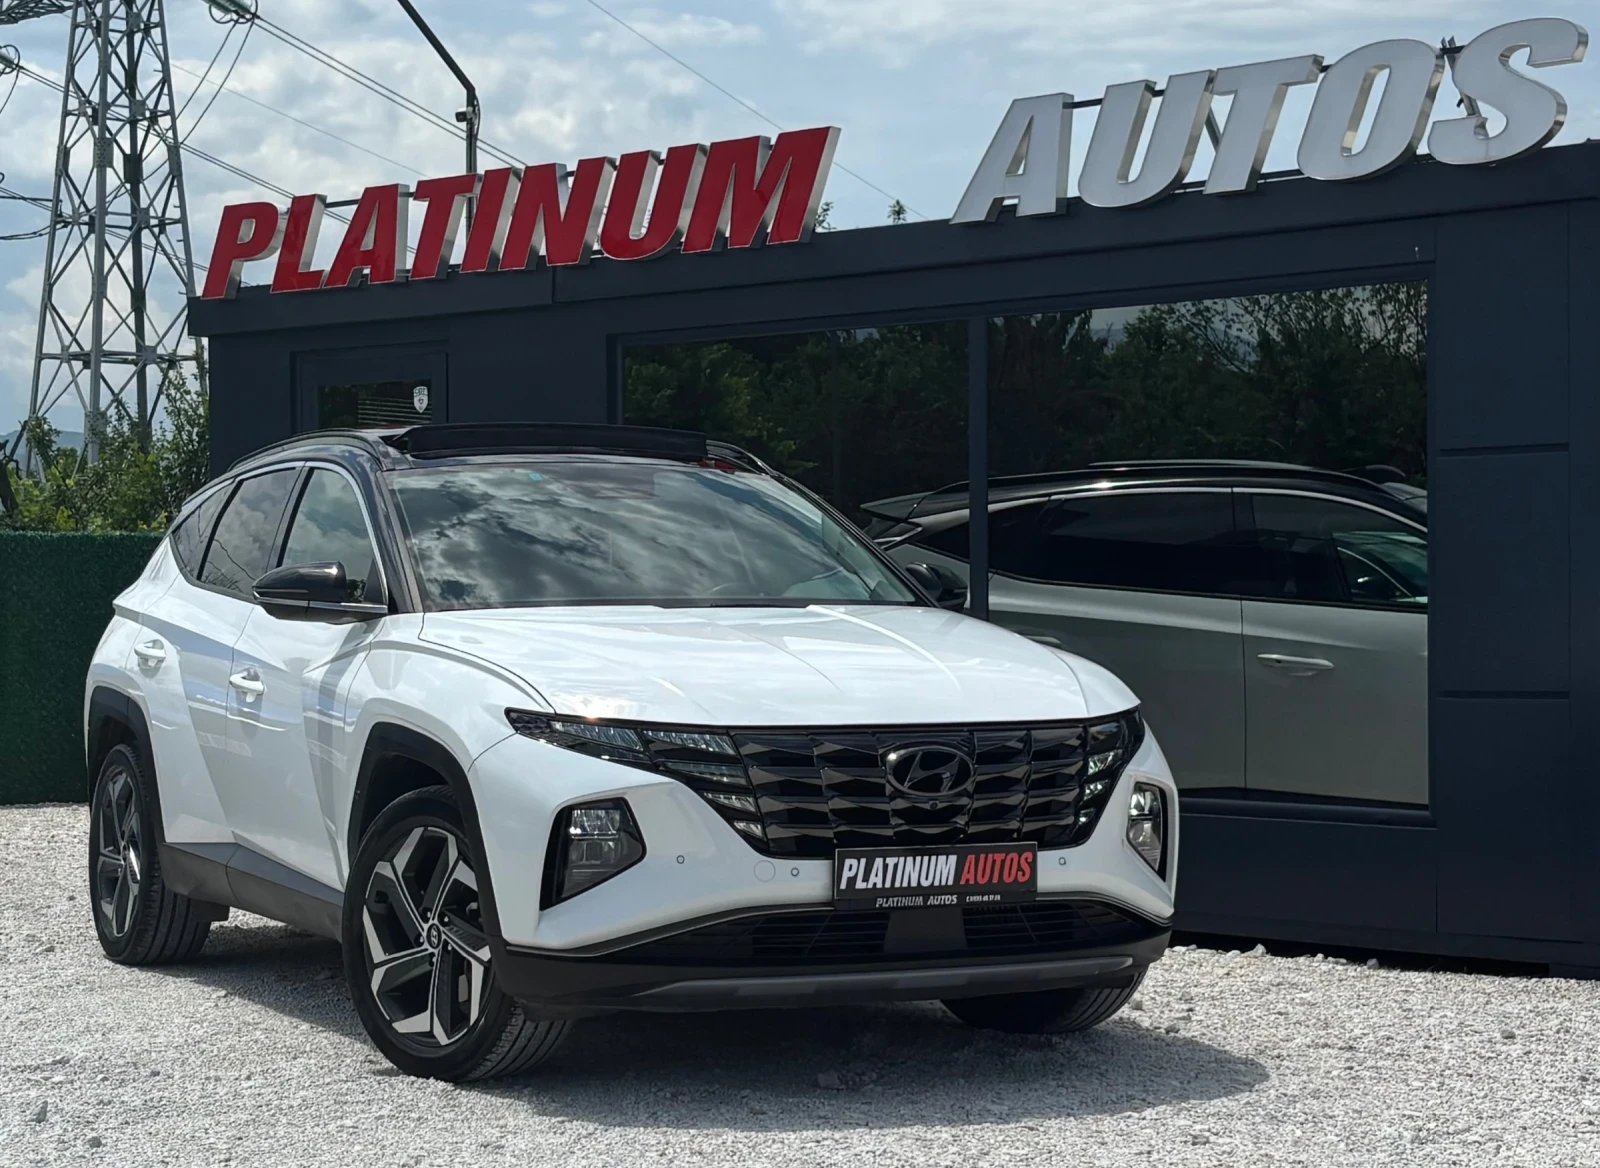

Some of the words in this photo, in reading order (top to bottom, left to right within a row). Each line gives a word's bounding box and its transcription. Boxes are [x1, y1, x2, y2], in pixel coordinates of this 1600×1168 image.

[201, 126, 841, 300] PLATINUM
[949, 17, 1588, 225] AUTOS
[840, 855, 957, 890] PLATINUM
[960, 852, 1033, 885] AUTOS
[876, 897, 923, 908] PLATINUM
[927, 895, 958, 905] AUTOS
